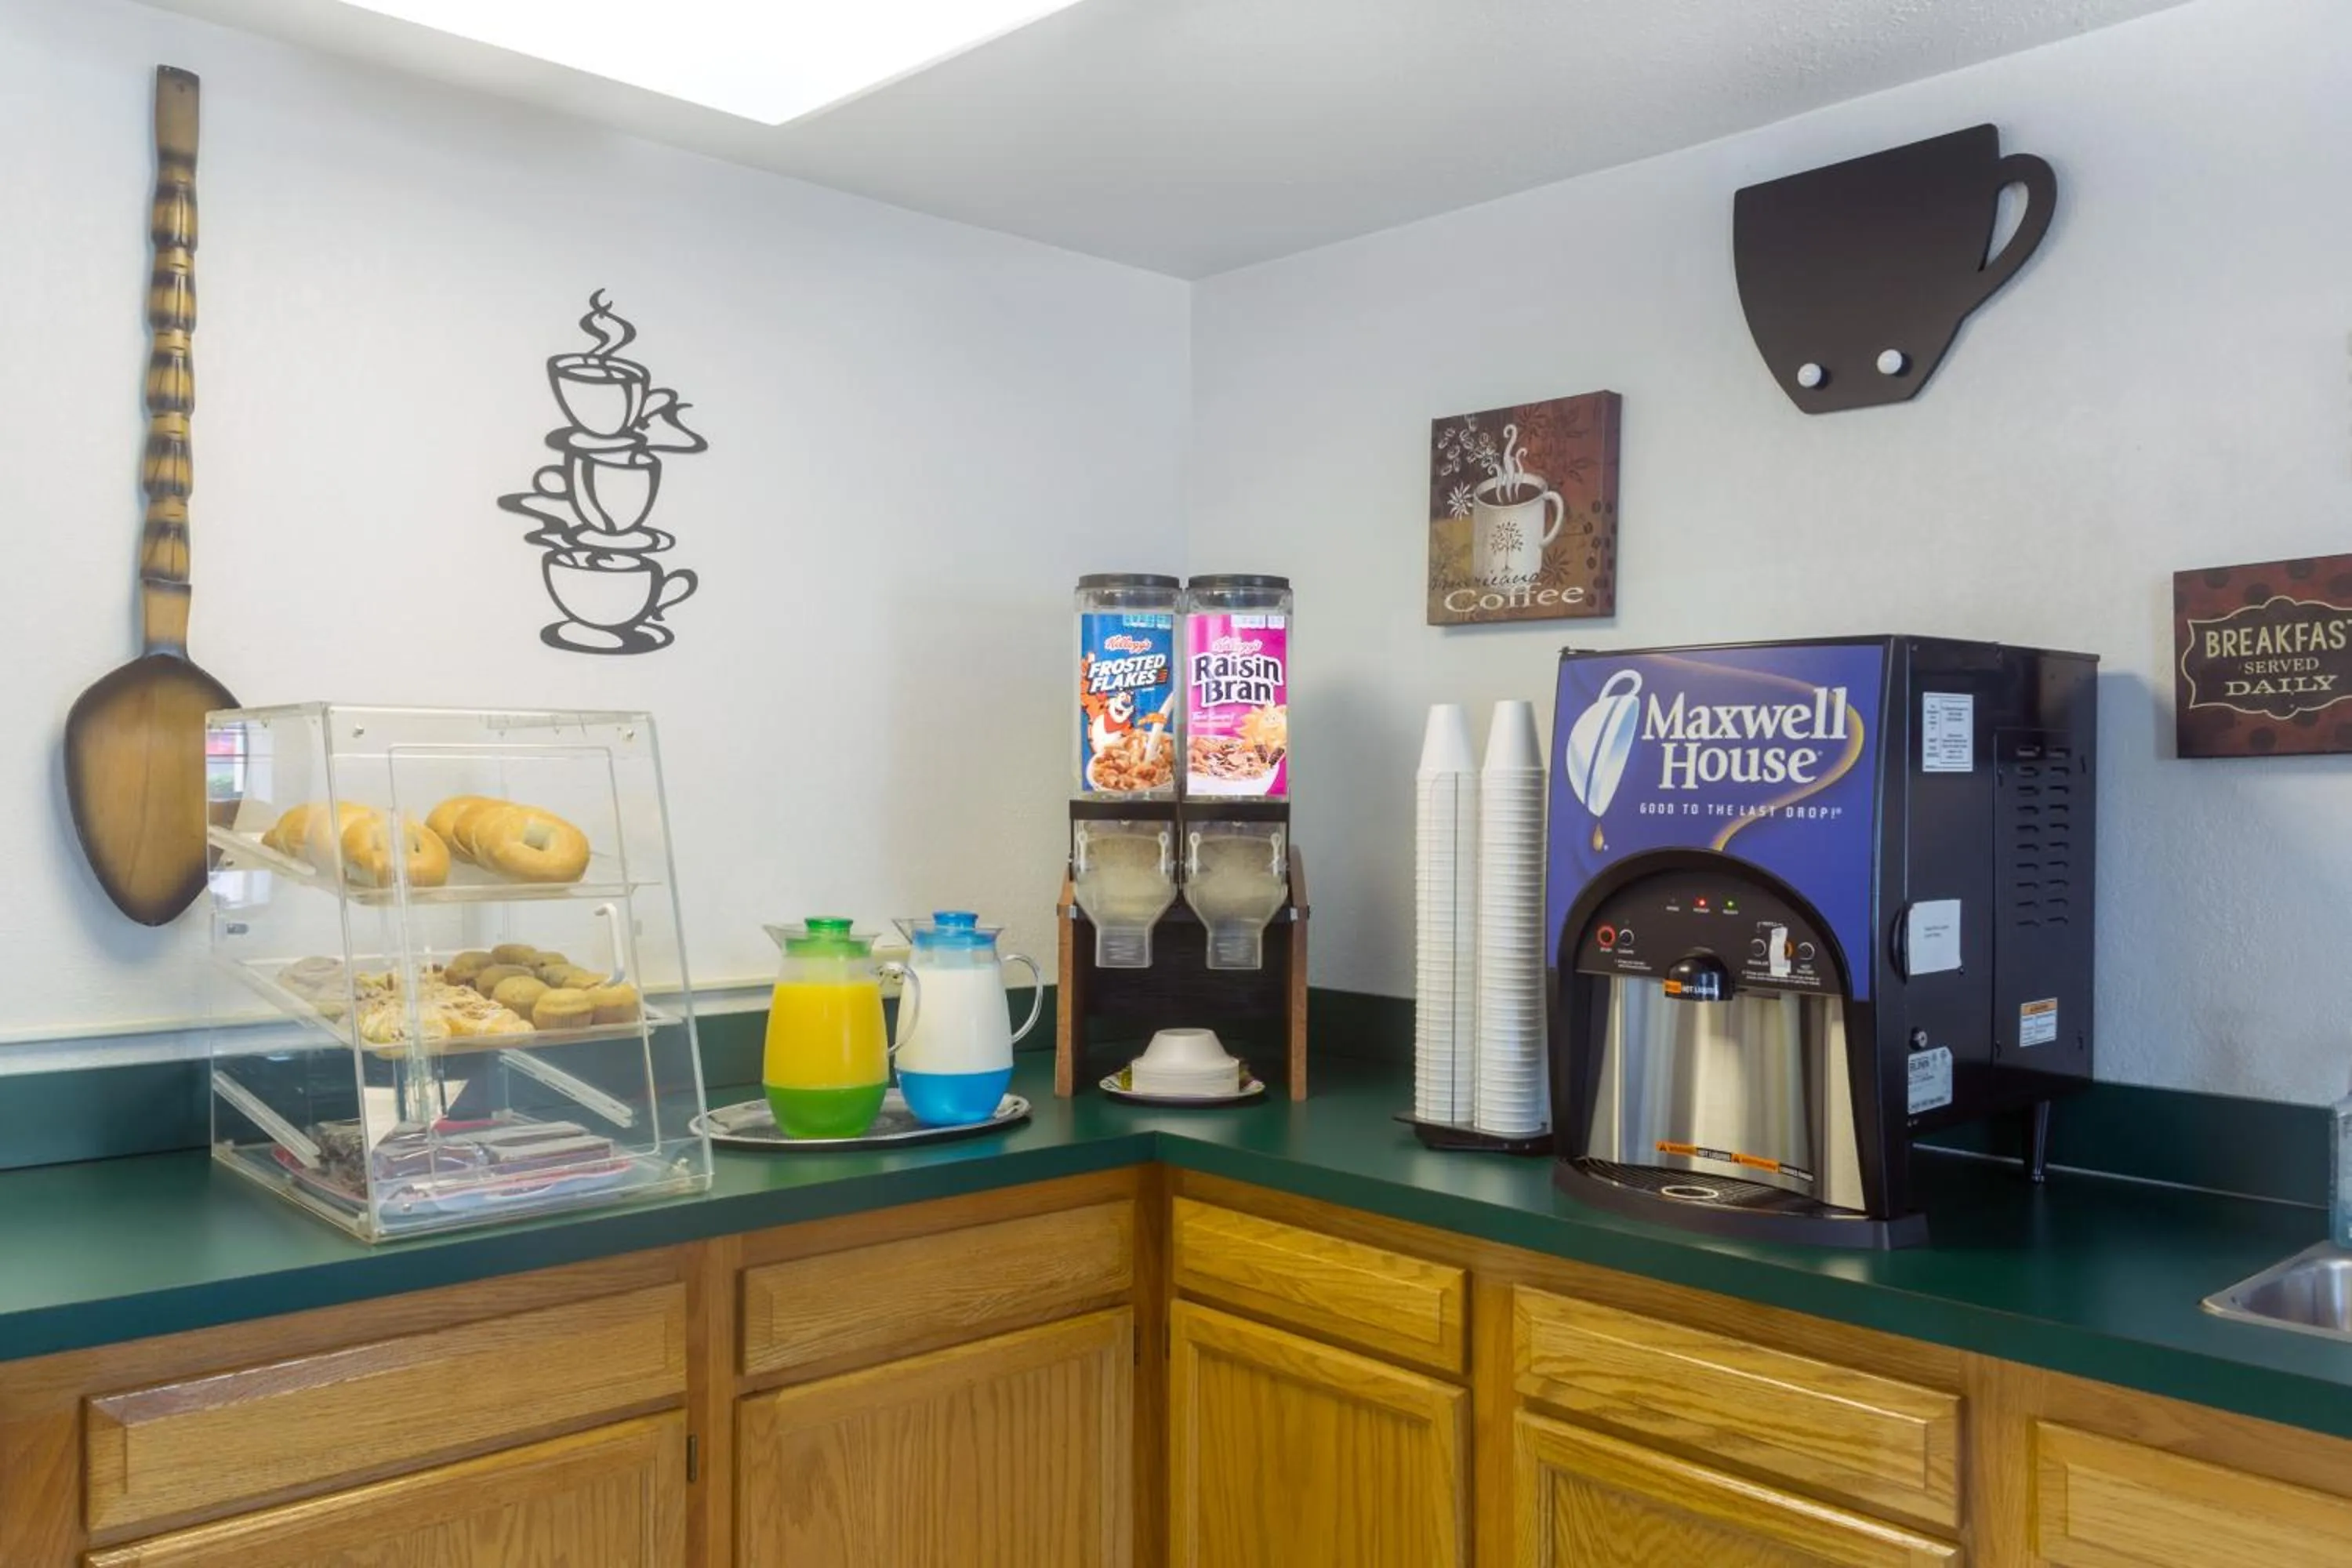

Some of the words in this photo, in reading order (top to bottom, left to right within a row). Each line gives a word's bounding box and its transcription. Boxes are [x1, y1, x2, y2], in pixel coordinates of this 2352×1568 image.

[1444, 583, 1584, 613] Coffee
[2205, 620, 2352, 658] BREAKFAS
[1088, 654, 1166, 678] FROSTED
[1194, 655, 1280, 683] Raisin
[2244, 658, 2319, 675] SERVED
[1089, 669, 1158, 693] FLAKES
[1204, 679, 1272, 703] Bran
[2225, 675, 2339, 696] DAILY
[1642, 687, 1848, 740] Maxwell
[1658, 742, 1818, 789] House
[1639, 803, 1675, 815] GOOD
[1682, 804, 1699, 815] TO
[1708, 804, 1734, 816] THE
[1739, 804, 1776, 818] LAST
